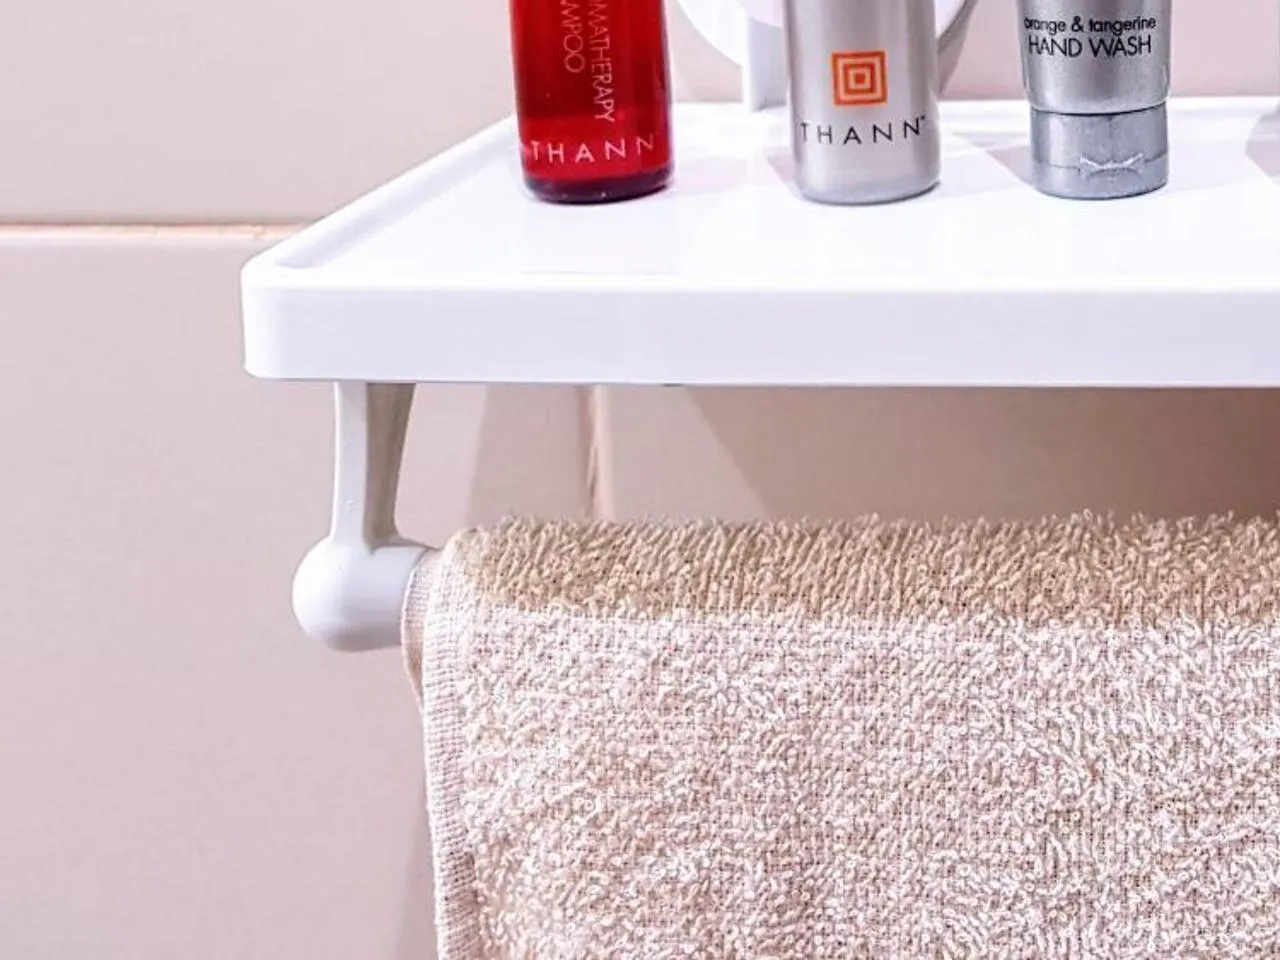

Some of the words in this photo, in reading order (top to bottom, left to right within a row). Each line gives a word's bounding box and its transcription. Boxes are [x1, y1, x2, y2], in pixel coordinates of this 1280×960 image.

[1023, 17, 1067, 36] orange
[1071, 15, 1084, 33] &
[1088, 15, 1157, 37] tangerine
[1028, 34, 1083, 58] HAND
[1088, 34, 1152, 58] WASH
[800, 116, 921, 146] THANN
[529, 133, 656, 165] THANN
